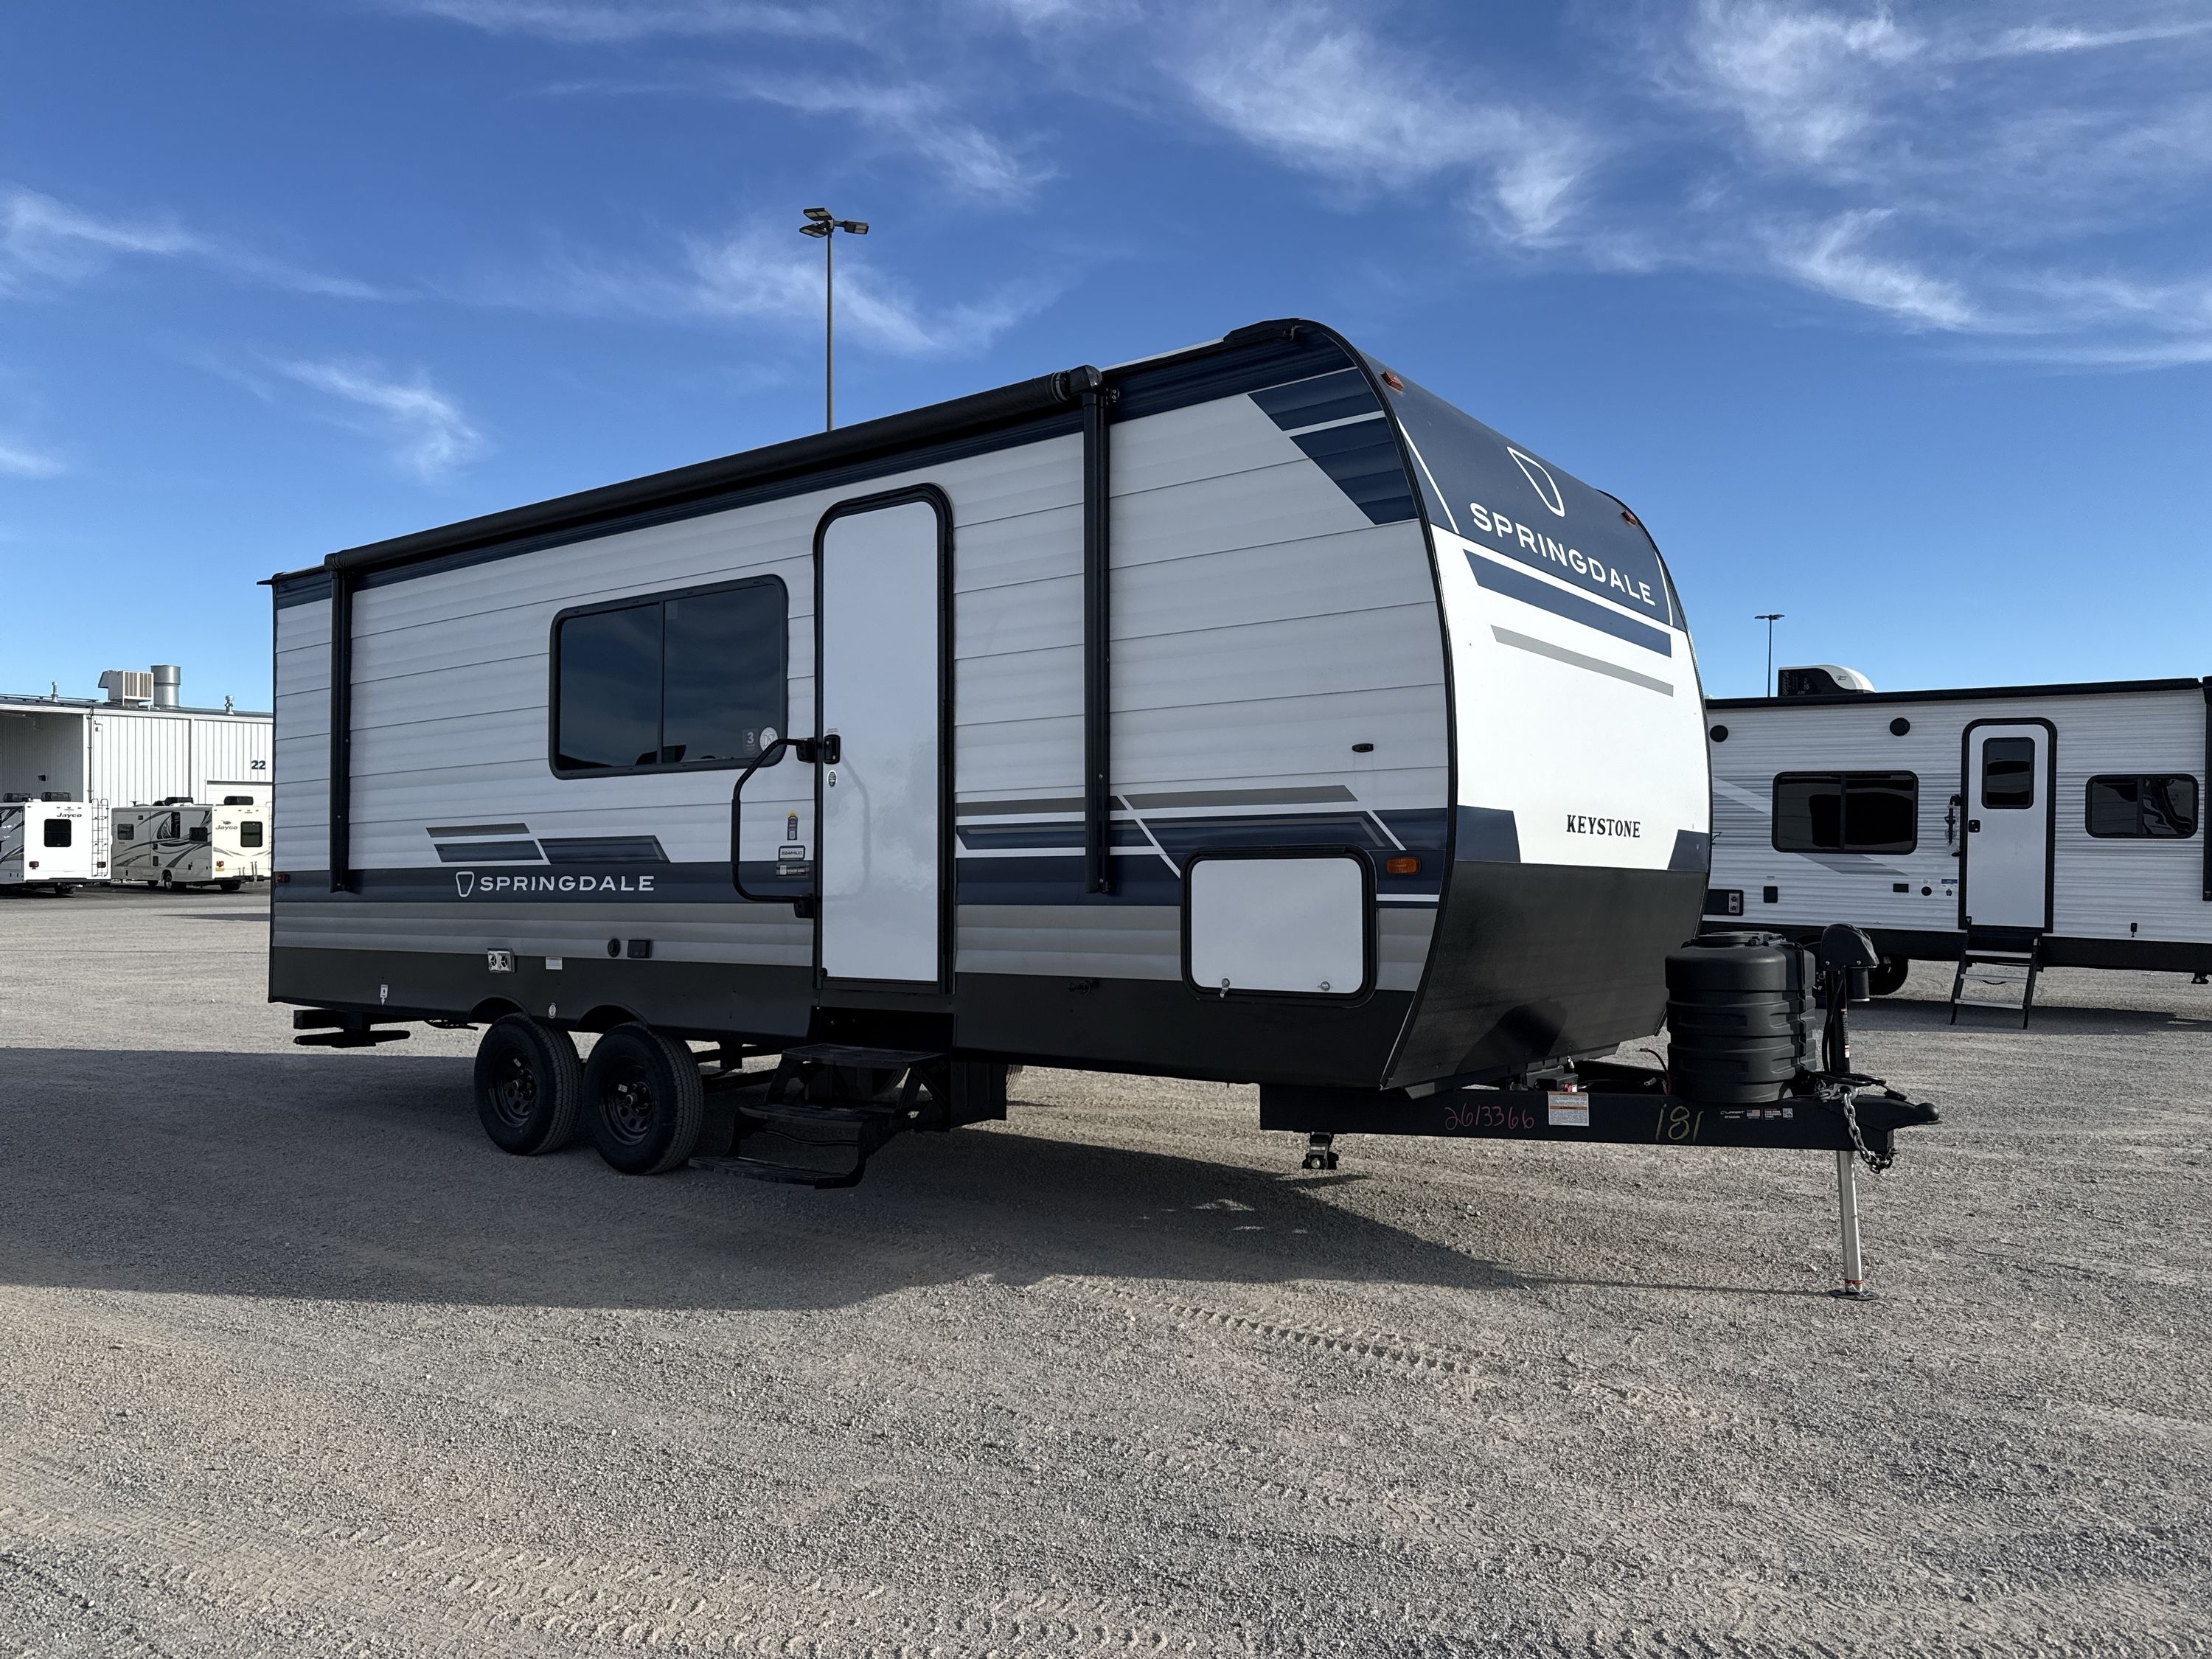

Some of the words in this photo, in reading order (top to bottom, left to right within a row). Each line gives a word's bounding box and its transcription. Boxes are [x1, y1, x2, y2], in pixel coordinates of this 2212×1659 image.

[1470, 502, 1656, 606] SPRINGDALE
[747, 731, 754, 744] 3
[251, 759, 266, 770] 22
[1565, 814, 1641, 838] KEYSTONE
[479, 875, 655, 891] SPRINGDALE
